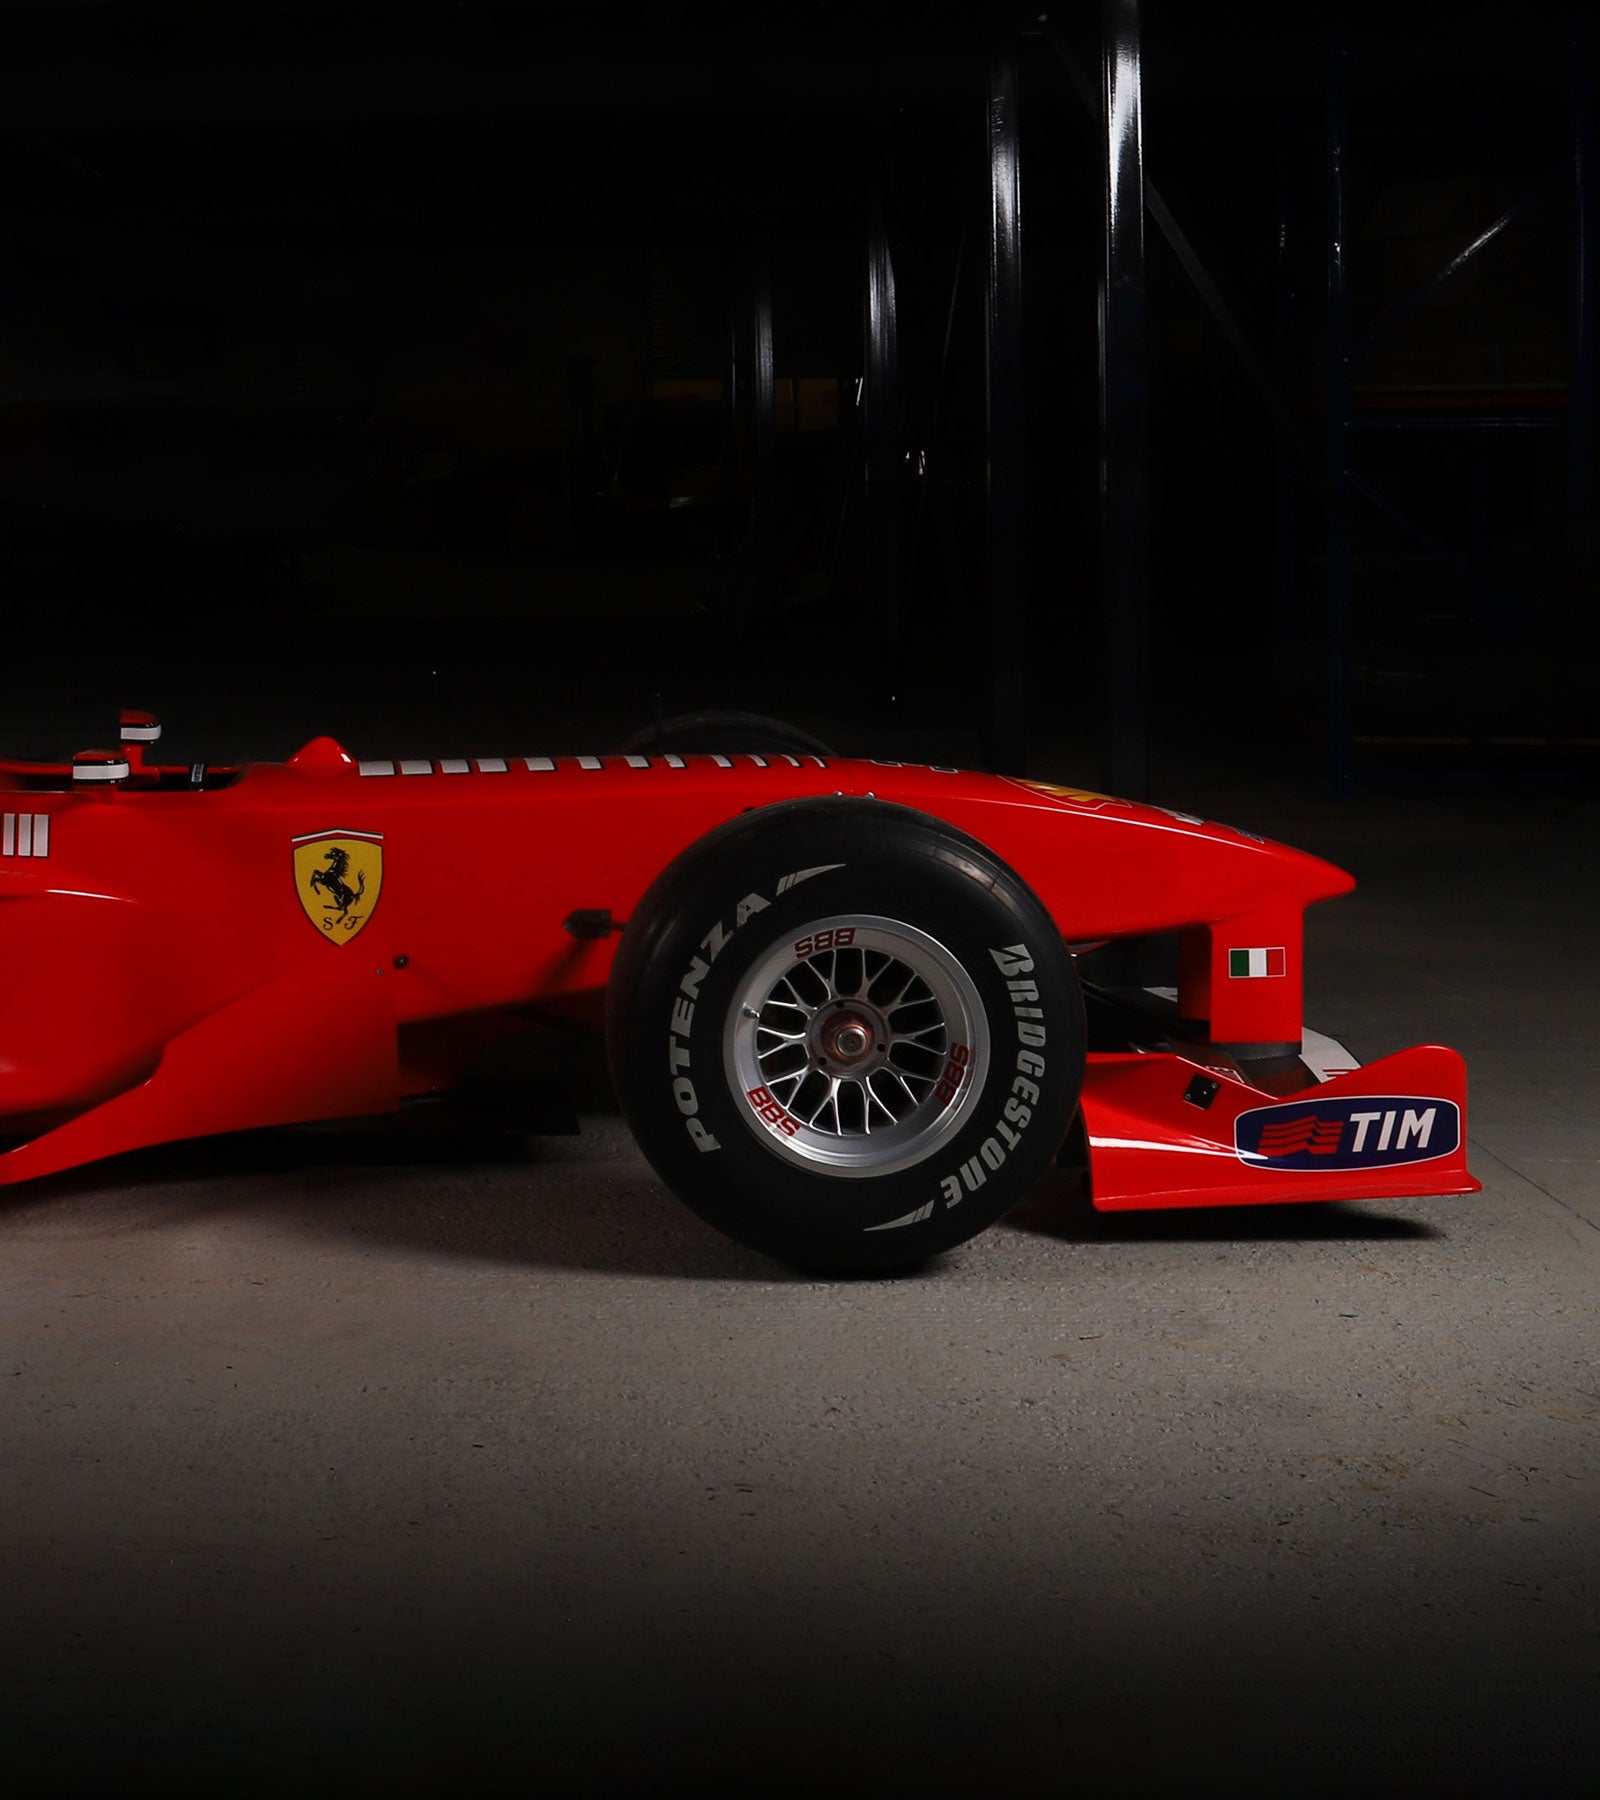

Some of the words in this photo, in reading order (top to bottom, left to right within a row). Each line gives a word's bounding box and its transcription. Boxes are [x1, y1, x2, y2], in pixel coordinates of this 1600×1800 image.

[322, 916, 334, 931] S
[794, 927, 857, 960] BBS
[668, 891, 772, 1153] POTENZA
[935, 1042, 971, 1107] BBS
[940, 943, 1046, 1209] BRIDGESTONE
[746, 1085, 801, 1137] BBS
[1348, 1107, 1437, 1154] TIM
